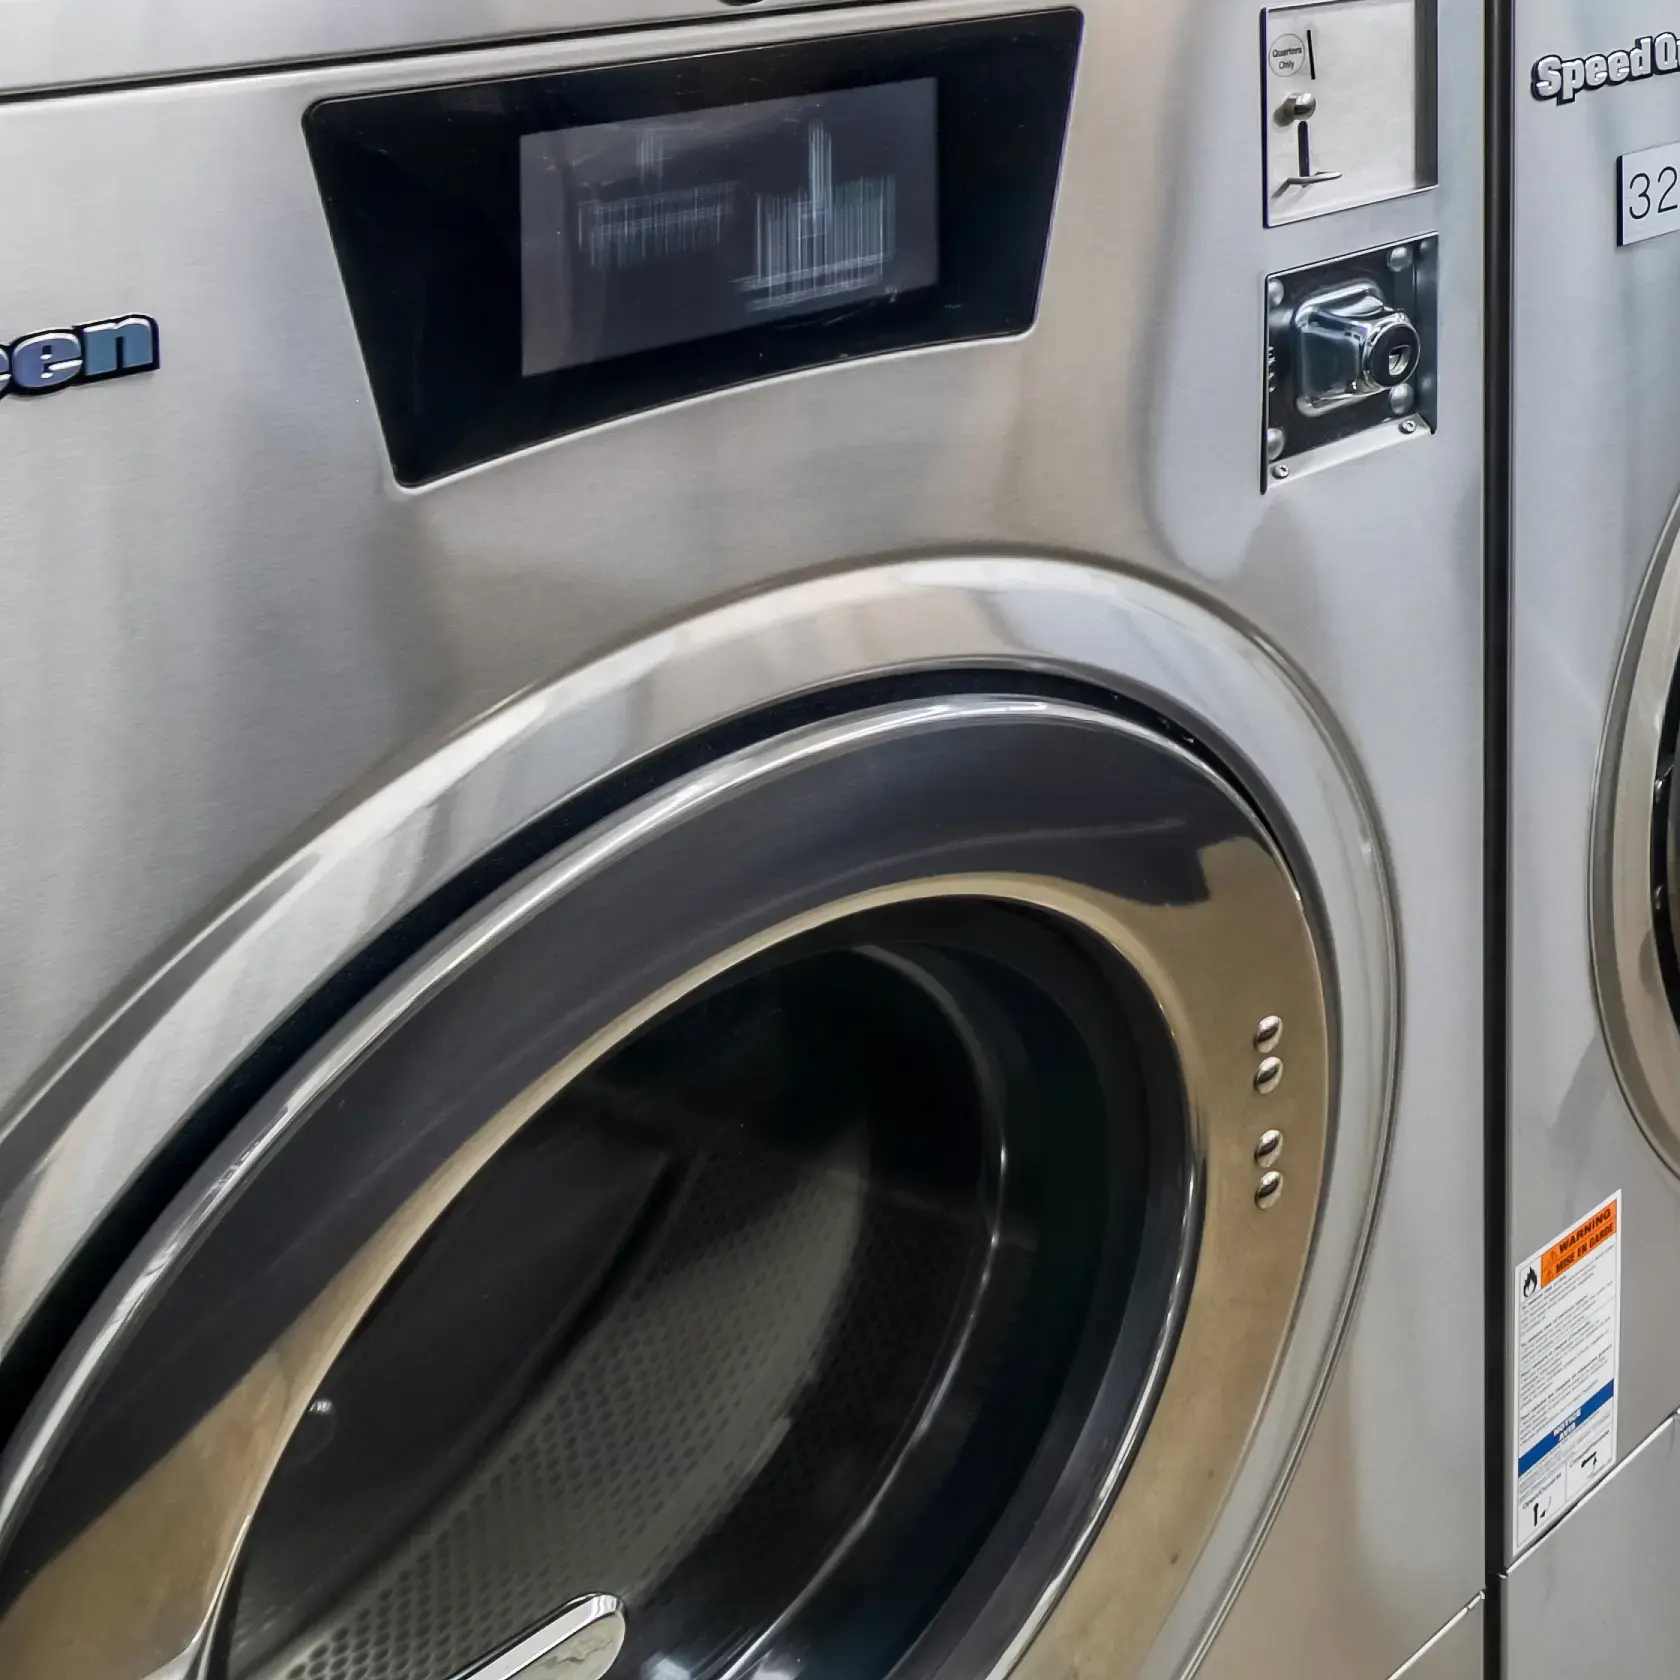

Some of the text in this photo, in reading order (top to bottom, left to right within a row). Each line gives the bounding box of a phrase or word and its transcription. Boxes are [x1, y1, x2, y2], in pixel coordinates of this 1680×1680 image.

[1279, 61, 1294, 70] Only
[1531, 36, 1655, 106] Speed
[1629, 165, 1679, 221] 32
[1559, 1208, 1612, 1253] WARNING
